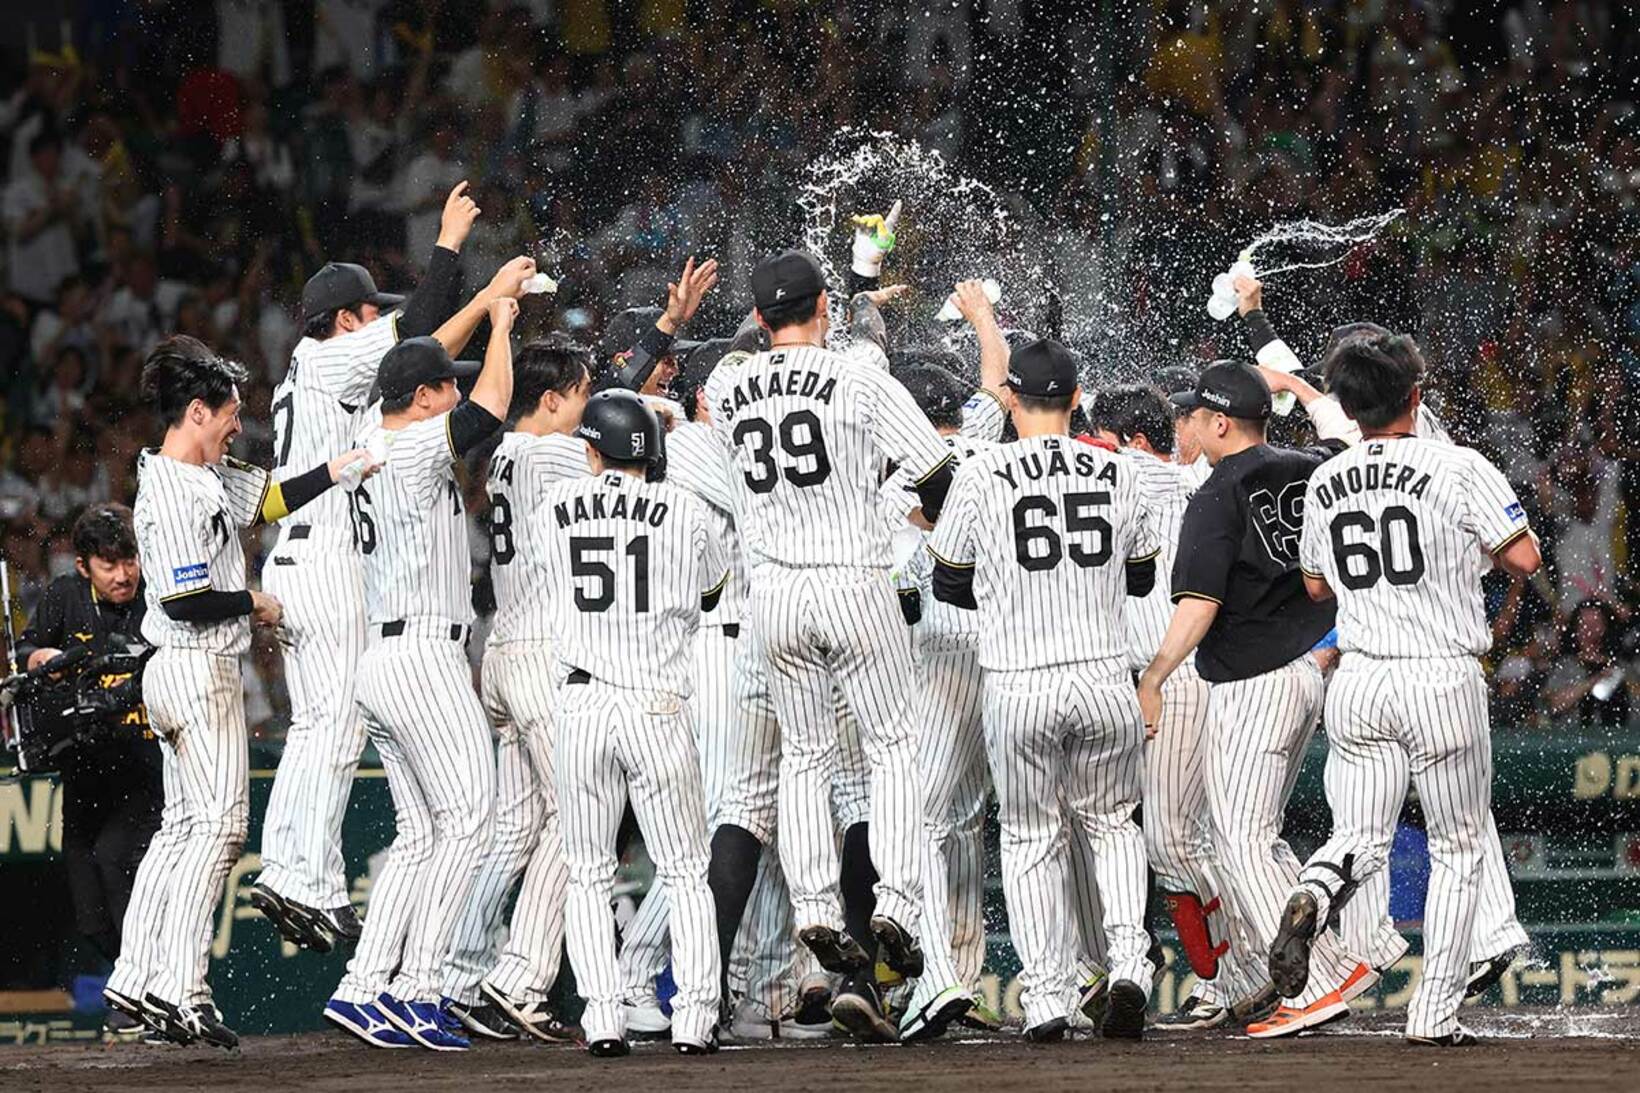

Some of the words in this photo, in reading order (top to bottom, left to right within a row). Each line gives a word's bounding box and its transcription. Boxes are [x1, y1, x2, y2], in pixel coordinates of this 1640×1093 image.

[722, 370, 837, 421] SAKAEDA
[1202, 388, 1231, 408] Joshin
[631, 432, 645, 446] 51
[732, 409, 832, 494] 39
[993, 450, 1118, 490] YUASA
[1315, 462, 1432, 510] ONODERA
[553, 493, 669, 530] NAKANO
[1012, 491, 1114, 572] 65
[1329, 505, 1425, 591] 60
[175, 567, 209, 581] Joshin
[569, 535, 649, 613] 51
